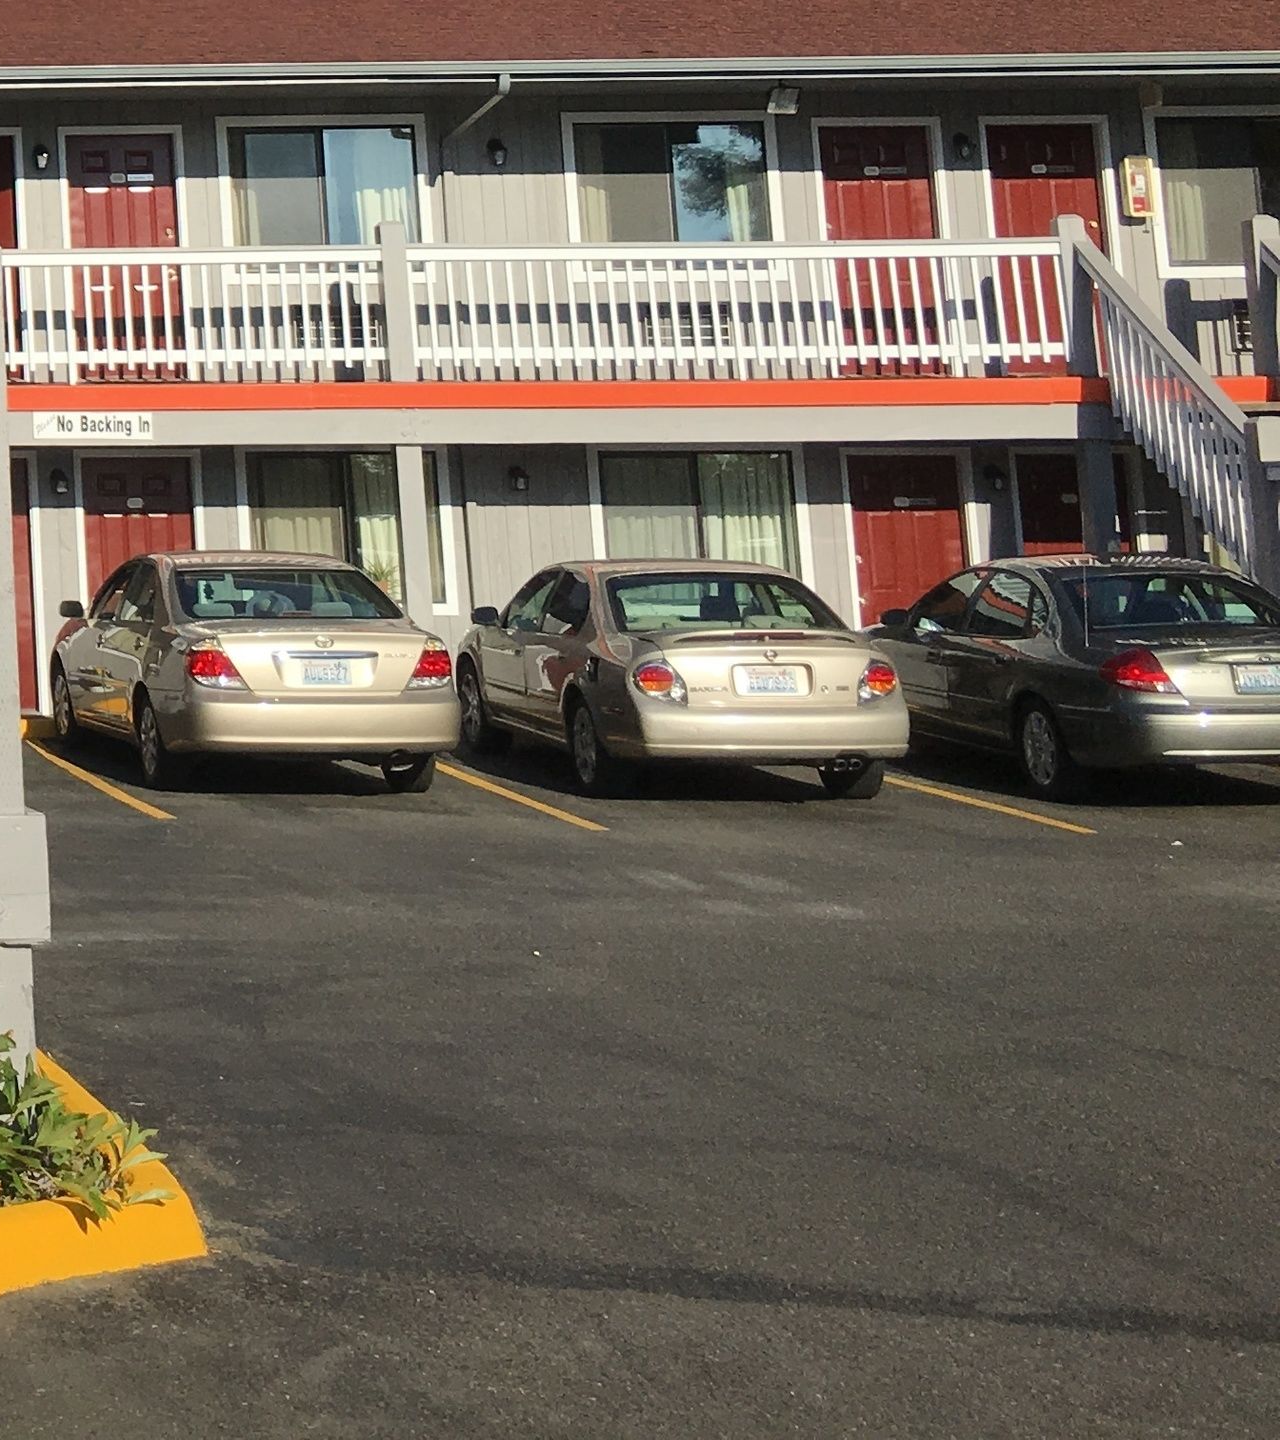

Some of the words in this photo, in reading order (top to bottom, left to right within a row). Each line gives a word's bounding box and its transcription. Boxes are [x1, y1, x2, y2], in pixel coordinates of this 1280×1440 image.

[57, 415, 73, 432] No
[80, 415, 132, 436] Backing
[139, 416, 150, 432] In
